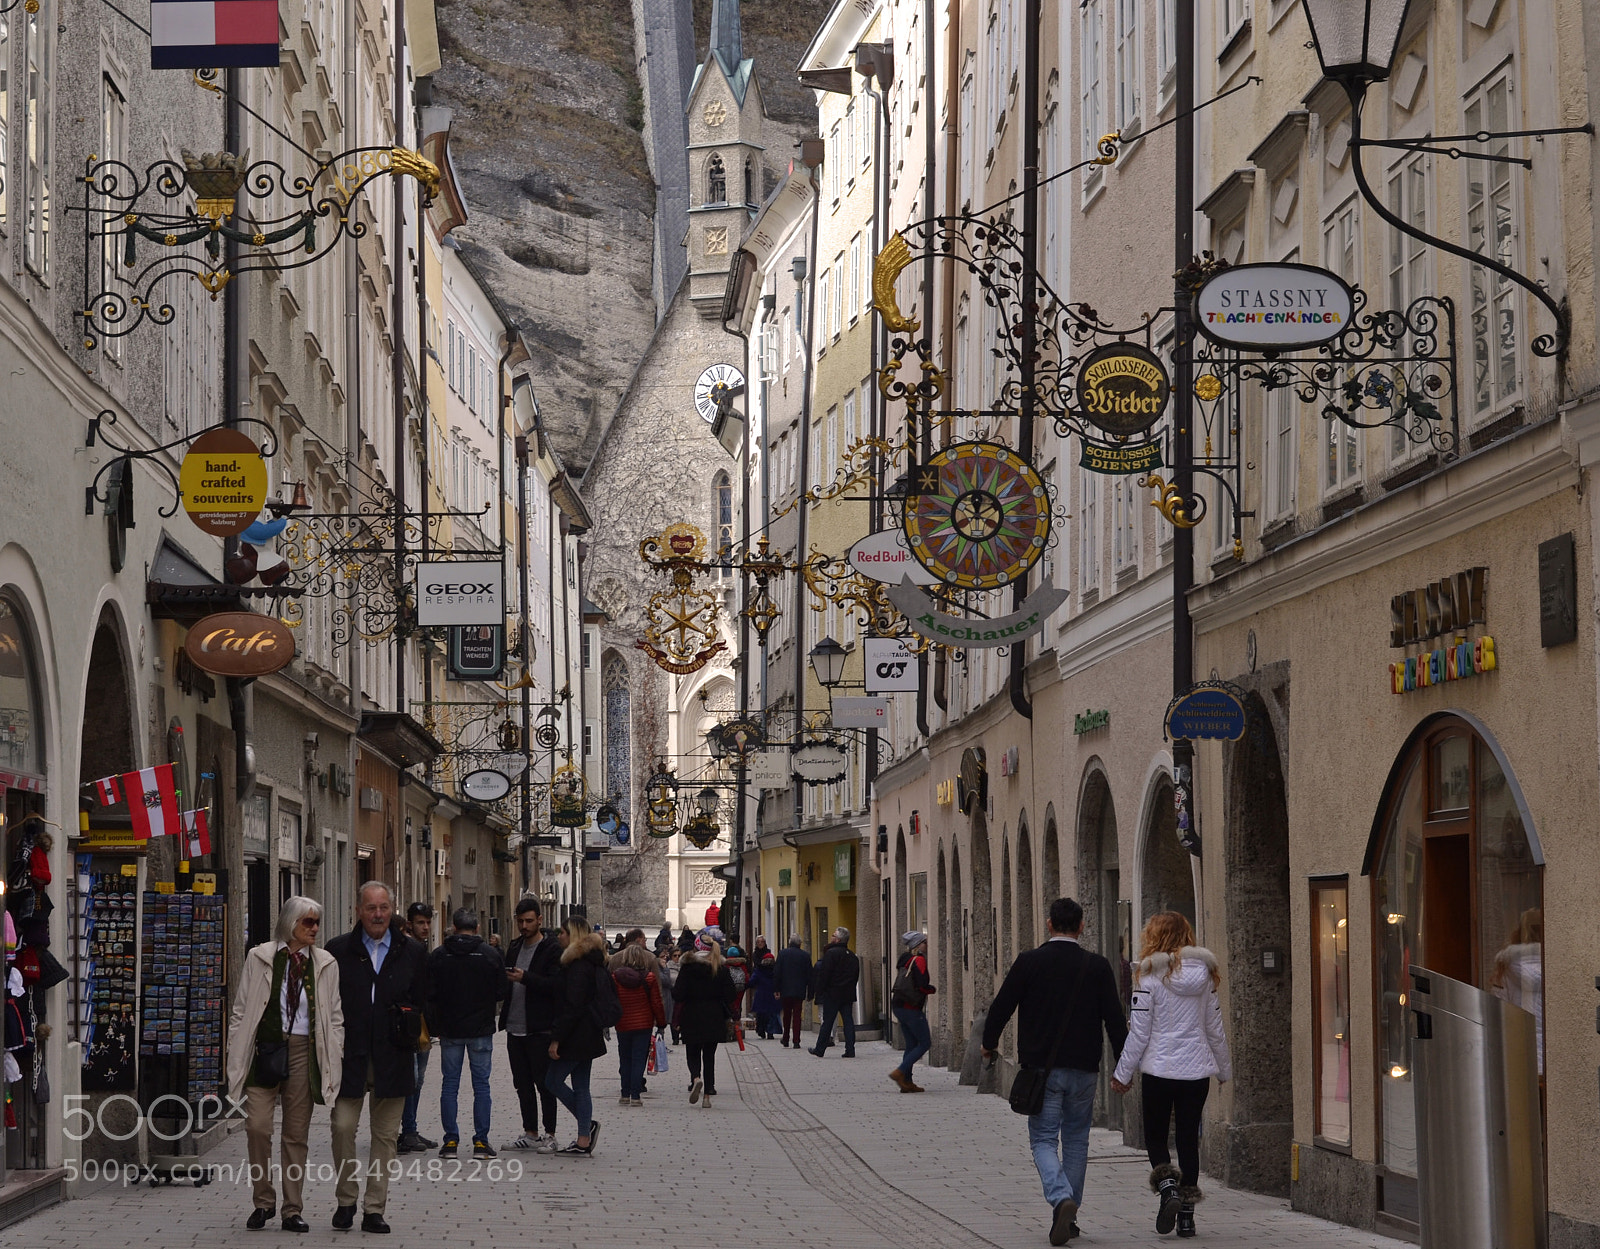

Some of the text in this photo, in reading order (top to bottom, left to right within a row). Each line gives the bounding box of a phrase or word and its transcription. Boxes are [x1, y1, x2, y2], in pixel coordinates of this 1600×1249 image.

[334, 150, 392, 206] 1980
[1221, 289, 1328, 308] STASSNY
[1088, 359, 1159, 383] SCHLOSSEREI
[1083, 385, 1162, 414] Wieber
[1085, 444, 1160, 460] SCHLÜSSEL
[205, 460, 241, 473] hand-
[1090, 457, 1152, 471] DIENST
[201, 475, 246, 488] crafted
[192, 491, 254, 504] souvenirs
[210, 518, 236, 526] Salzburg
[857, 550, 905, 562] Red Bull
[425, 583, 495, 595] GEOX
[425, 596, 495, 604] RESPIRA
[1390, 566, 1490, 648] STASSNY
[915, 611, 1040, 641] Aschauer
[200, 628, 278, 656] Café
[1176, 709, 1239, 718] Schlüsseldienst
[1182, 721, 1231, 731] WIEBER
[755, 772, 783, 780] philoro
